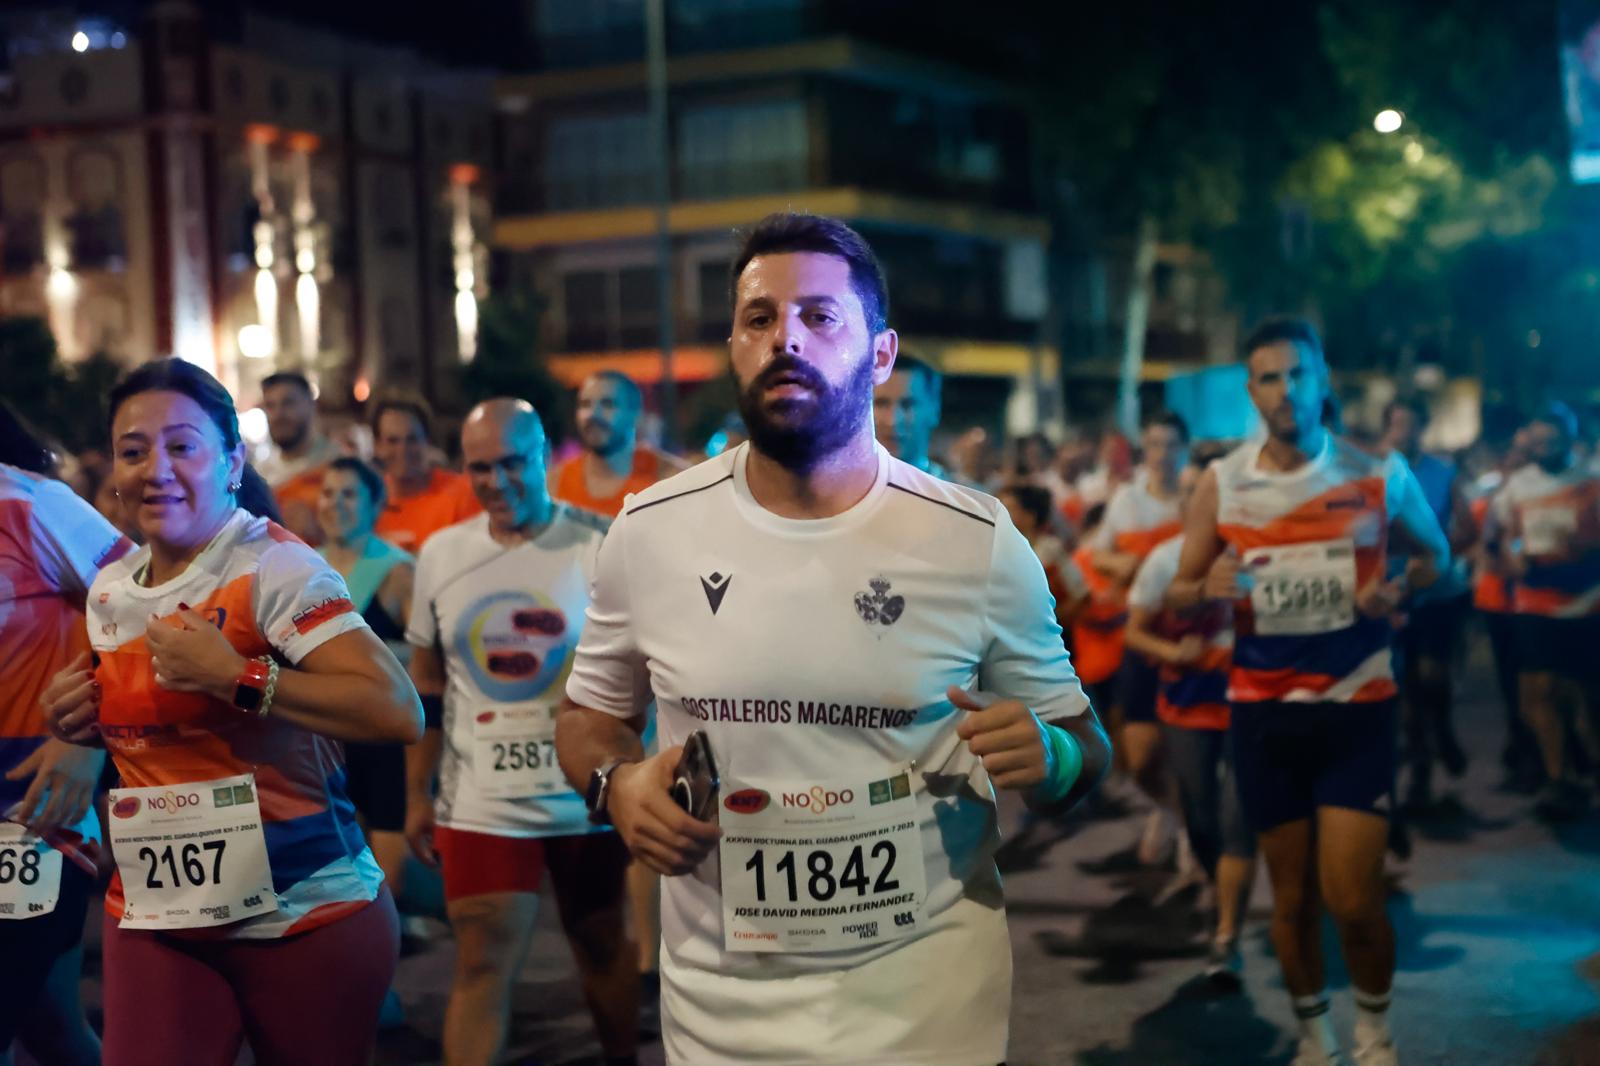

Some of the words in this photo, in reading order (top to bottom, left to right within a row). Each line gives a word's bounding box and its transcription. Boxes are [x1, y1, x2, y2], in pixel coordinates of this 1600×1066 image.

[681, 697, 792, 723] COSTALEROS
[798, 701, 917, 729] MACARENOS
[493, 740, 554, 771] 2587
[753, 837, 797, 846] NOCTURNA
[799, 838, 814, 846] DEL
[815, 829, 877, 846] GUADALQUIVIR
[0, 848, 40, 886] 68
[139, 839, 226, 889] 2167
[746, 840, 900, 902] 11842
[735, 907, 760, 917] JOSE
[763, 907, 797, 918] DAVID
[800, 905, 847, 918] MEDINA
[849, 892, 915, 914] FERNANDEZ
[842, 921, 878, 934] POWER
